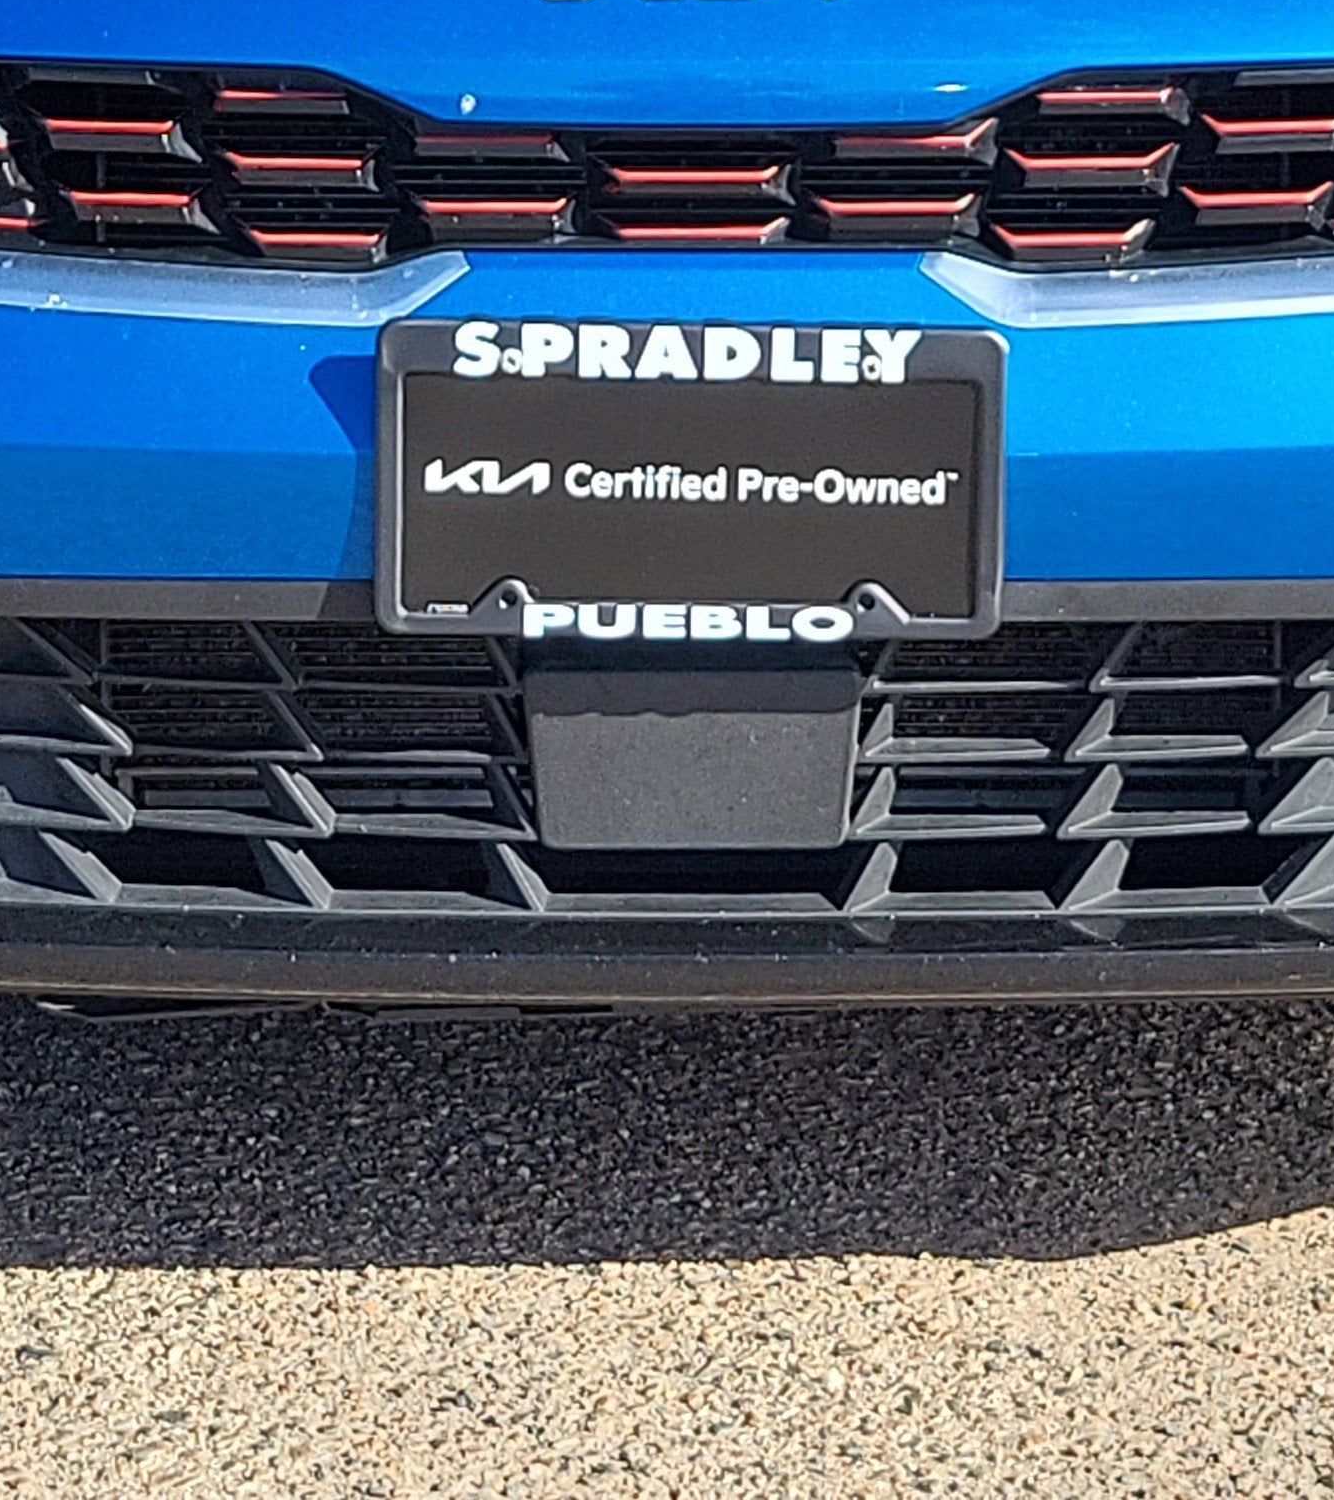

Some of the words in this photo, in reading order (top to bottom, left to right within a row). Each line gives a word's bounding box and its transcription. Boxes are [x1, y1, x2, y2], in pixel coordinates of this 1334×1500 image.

[453, 321, 922, 383] SPRADLEY
[424, 459, 551, 494] KIA
[564, 463, 726, 501] Certified
[522, 603, 856, 641] PUEBLO
